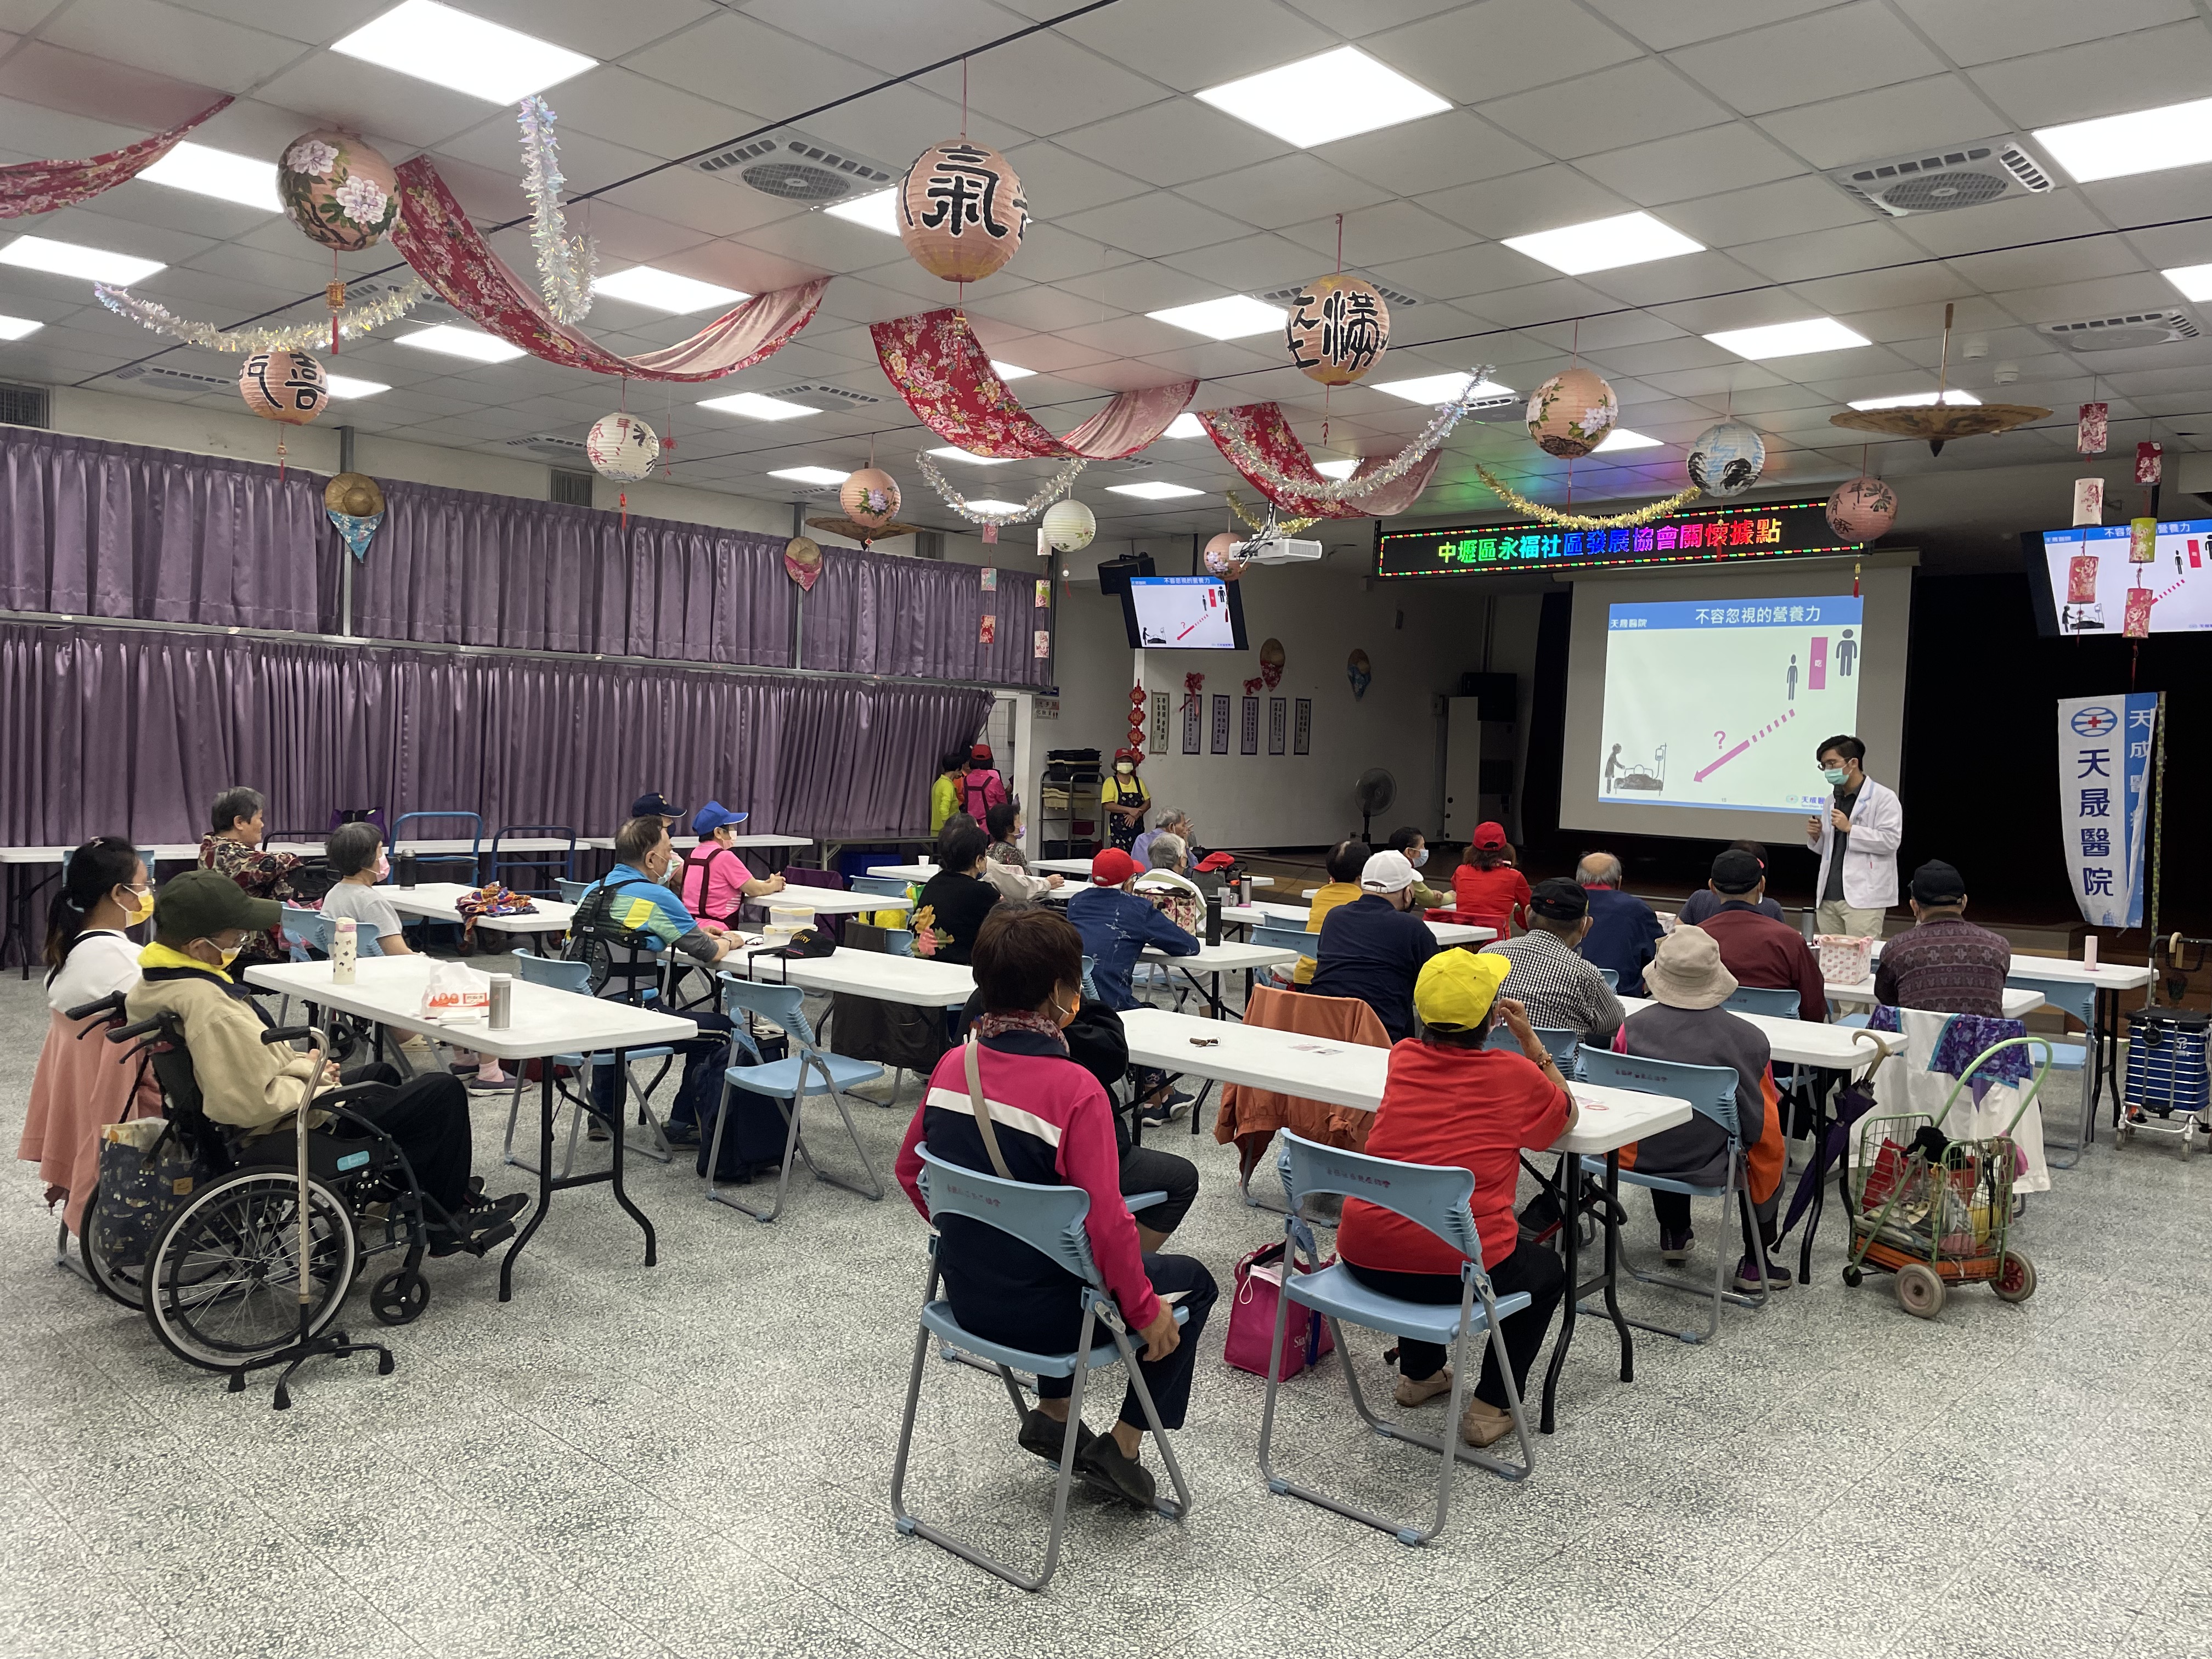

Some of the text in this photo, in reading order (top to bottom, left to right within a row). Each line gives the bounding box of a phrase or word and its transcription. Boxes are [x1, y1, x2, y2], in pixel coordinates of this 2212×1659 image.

[1438, 517, 1782, 564] 中壢區永福社區發展協會關懷據點
[1695, 605, 1821, 625] 不容忽視的營養力
[2078, 748, 2114, 896] 天晟醫院
